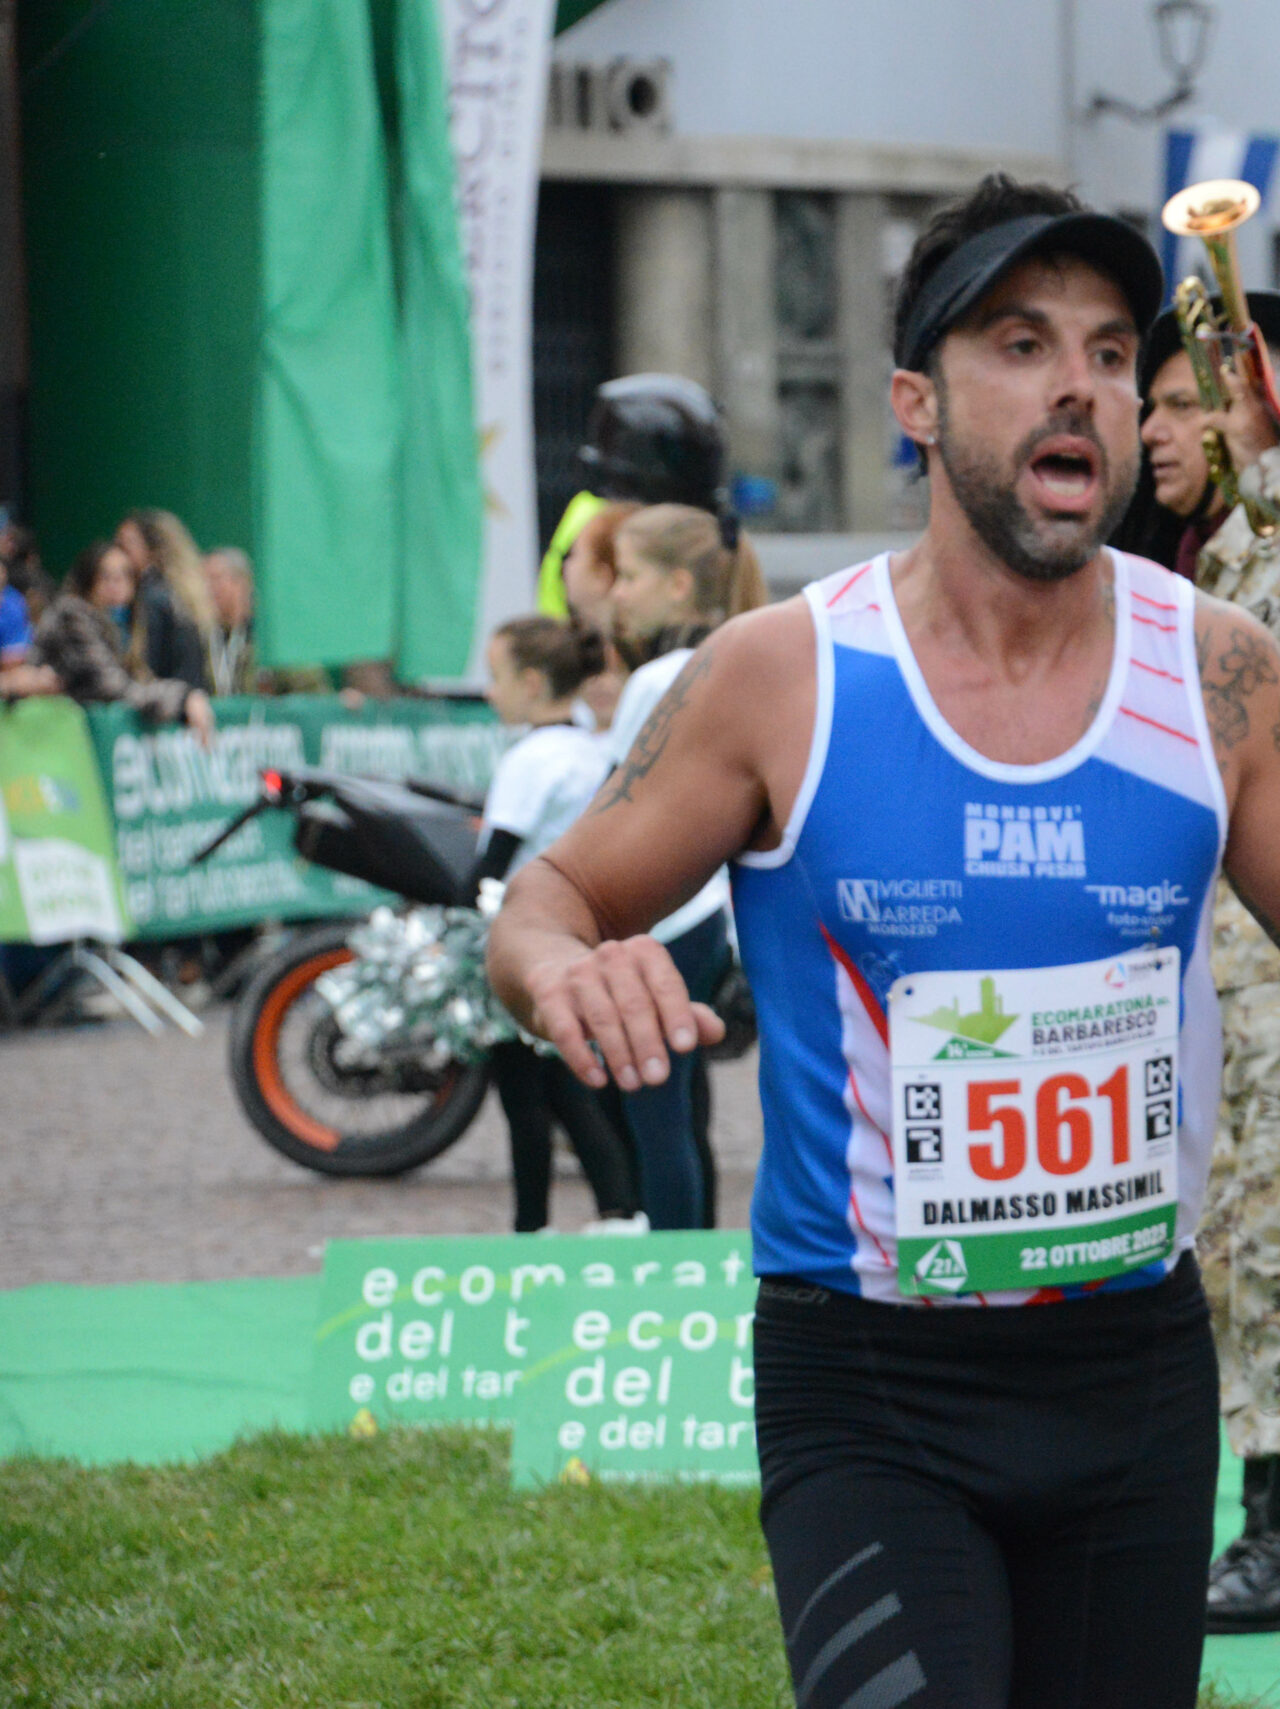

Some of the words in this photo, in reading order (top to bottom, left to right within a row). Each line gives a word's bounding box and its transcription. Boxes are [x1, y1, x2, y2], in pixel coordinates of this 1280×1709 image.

[964, 818, 1086, 862] PAM
[882, 905, 962, 923] ARREDA
[1084, 879, 1190, 912] magic
[1031, 994, 1153, 1027] ECOMARATONA
[1032, 1009, 1157, 1046] BARBARESCO
[965, 1063, 1131, 1181] 561
[923, 1191, 1058, 1226] DALMASSO
[1065, 1168, 1165, 1215] MASSIMIL
[1020, 1246, 1047, 1271] 22
[1051, 1232, 1132, 1267] OTTOBRE
[355, 1309, 455, 1362] del
[349, 1371, 376, 1403] e
[385, 1364, 449, 1401] del
[564, 1356, 673, 1407] del
[557, 1419, 587, 1450] e
[599, 1414, 667, 1451] del
